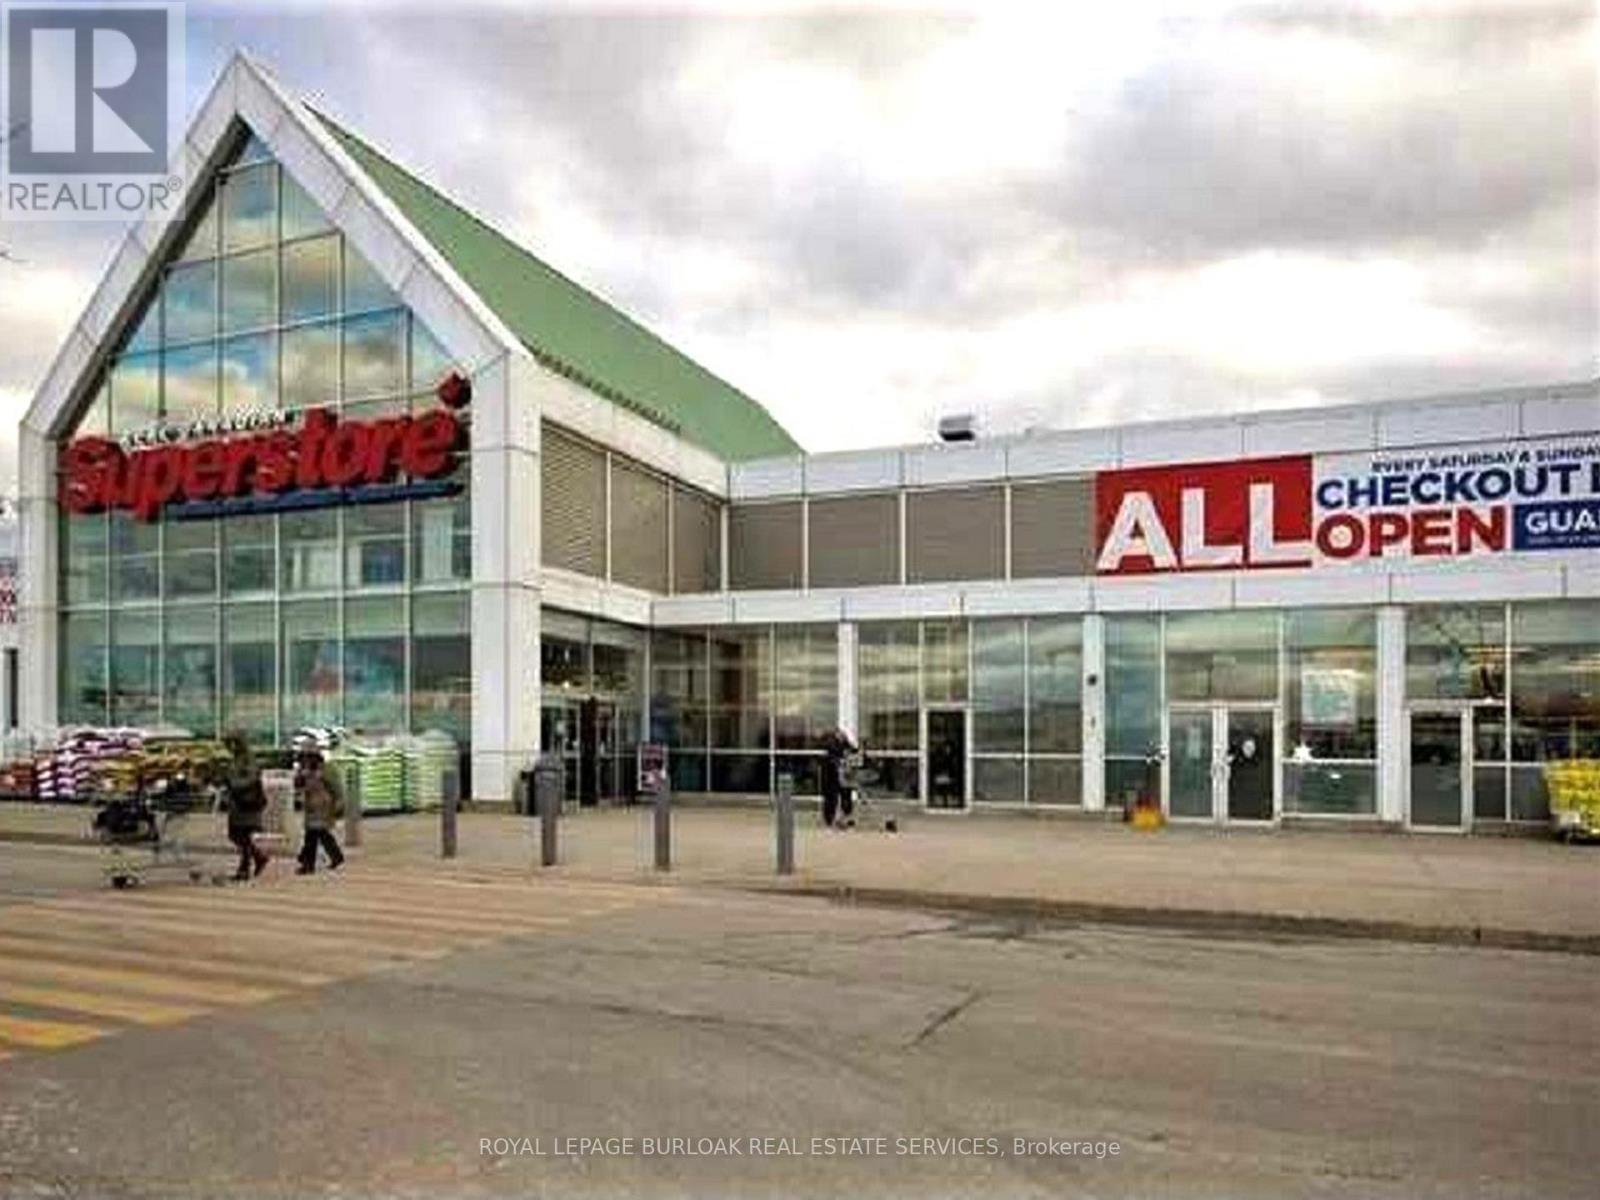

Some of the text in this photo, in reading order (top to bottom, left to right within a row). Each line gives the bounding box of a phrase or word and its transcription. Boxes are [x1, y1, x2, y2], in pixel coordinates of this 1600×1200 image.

[62, 406, 460, 523] Superstore
[1428, 451, 1514, 469] SATURDAY
[1316, 464, 1581, 510] CHECKOUT
[1097, 482, 1312, 570] ALL
[1316, 505, 1506, 558] OPEN
[1525, 508, 1600, 533] GUA
